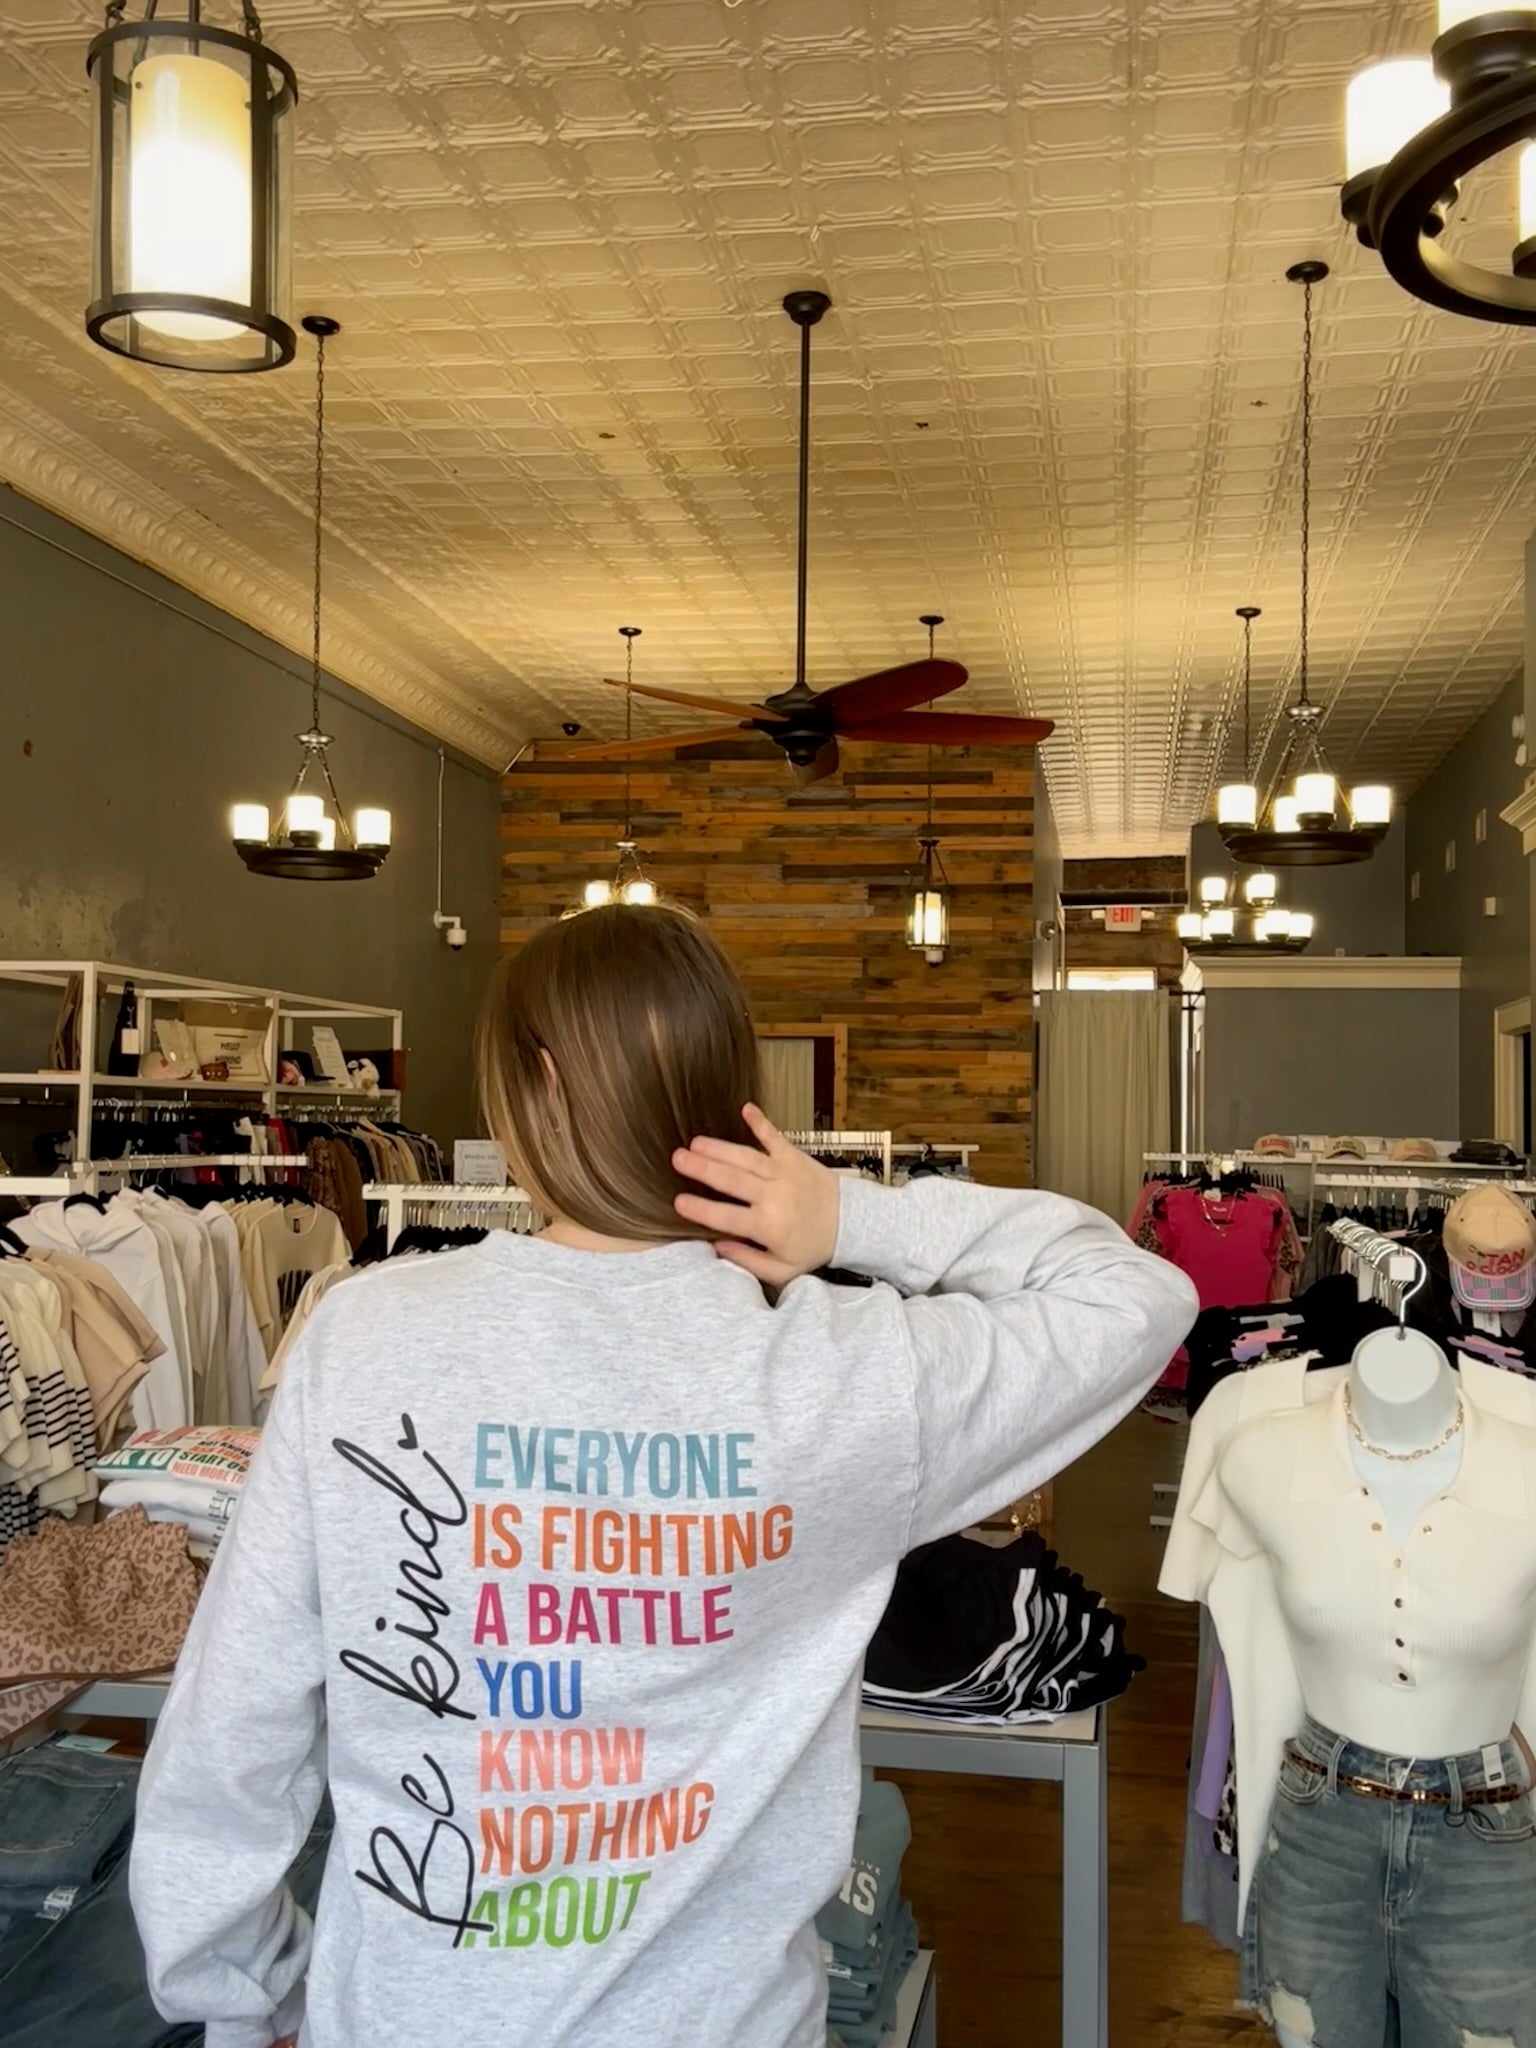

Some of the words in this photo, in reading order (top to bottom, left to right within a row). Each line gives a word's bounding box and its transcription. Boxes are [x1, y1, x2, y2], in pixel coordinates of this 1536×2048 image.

[172, 1462, 199, 1475] NEED
[179, 1451, 228, 1466] START
[220, 1442, 254, 1457] KNOW
[474, 1422, 758, 1499] EVERYONE
[473, 1503, 523, 1569] IS
[541, 1503, 794, 1577] FIGHTING
[332, 1437, 477, 1720] kind
[473, 1583, 509, 1645] A
[527, 1584, 735, 1646] BATTLE
[475, 1657, 582, 1720] YOU
[479, 1726, 646, 1793] KNOW
[355, 1753, 494, 1948] Be
[480, 1782, 716, 1877] NOTHING
[462, 1870, 653, 1949] ABOUT
